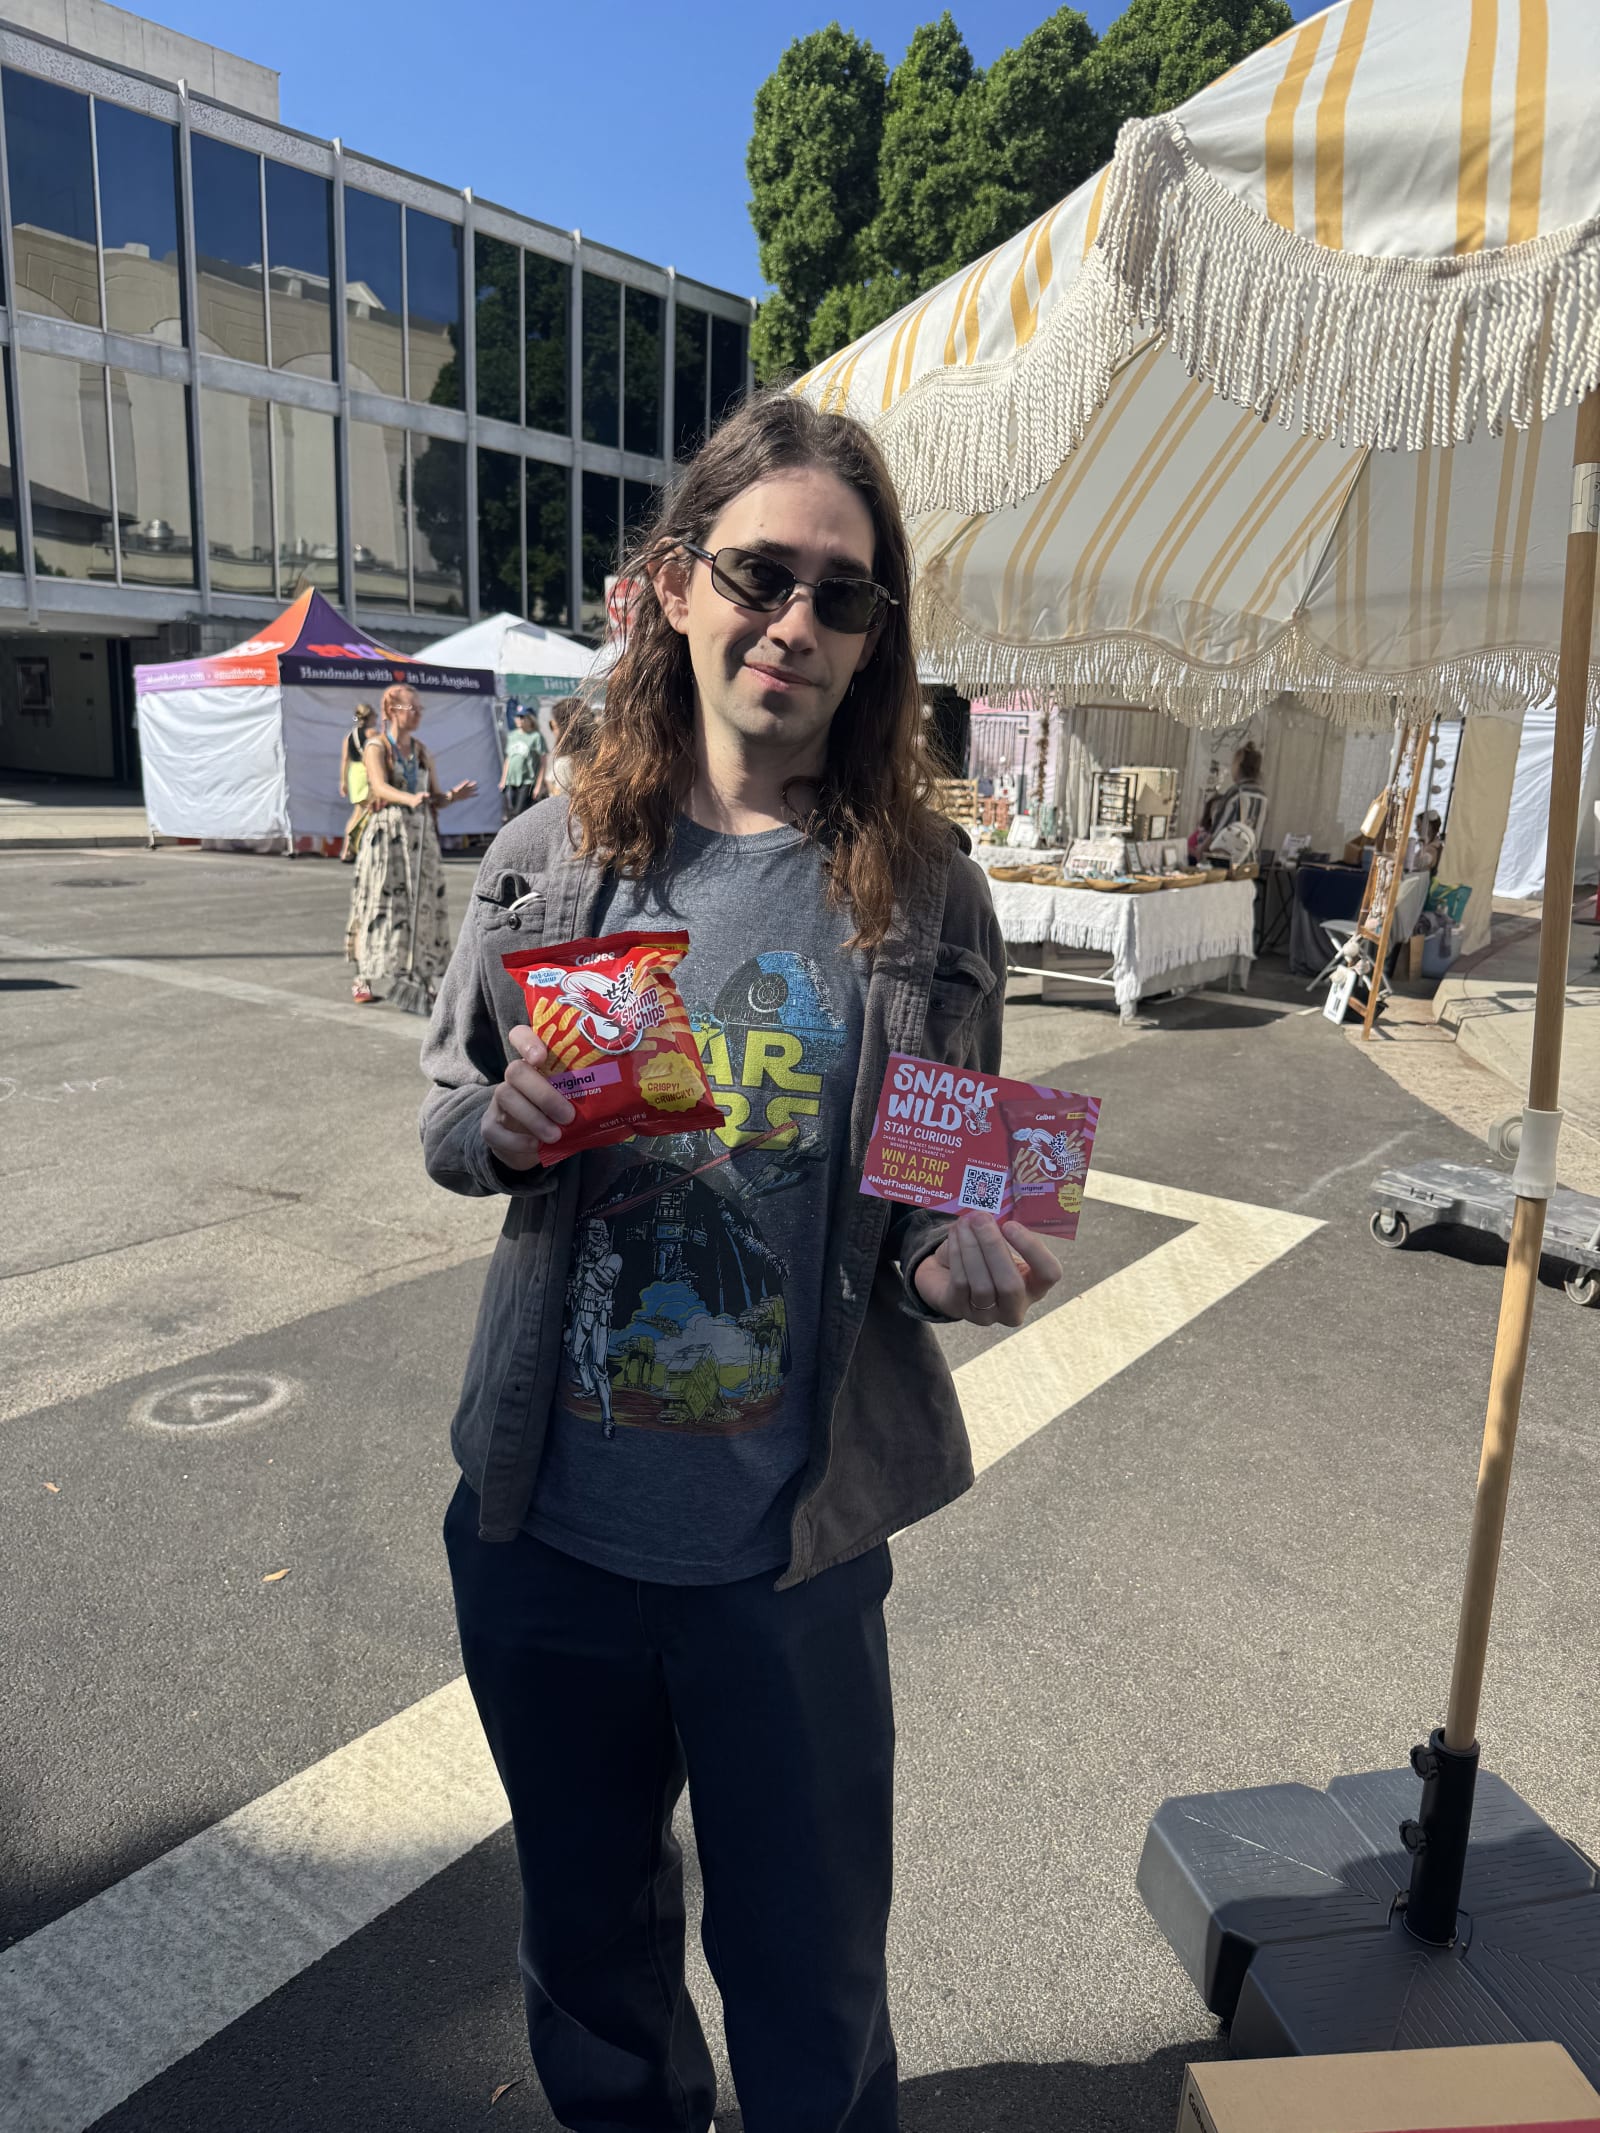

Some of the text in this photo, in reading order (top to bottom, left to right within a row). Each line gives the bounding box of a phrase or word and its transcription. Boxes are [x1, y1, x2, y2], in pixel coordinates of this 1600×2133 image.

[299, 666, 480, 689] Handmade with in Los Angeles
[575, 951, 616, 967] Calbee
[621, 988, 658, 1025] Shrimp
[634, 1004, 665, 1030] Chips
[552, 1072, 596, 1090] original
[647, 1082, 680, 1092] CRISPY!
[893, 1063, 998, 1108] SNACK
[655, 1087, 696, 1104] CRUNCHY!
[887, 1094, 962, 1131] WILD
[1035, 1113, 1056, 1121] Calbee
[883, 1120, 963, 1148] STAY CURIOUS
[881, 1147, 950, 1173] WIN A TRIP
[1057, 1152, 1080, 1165] Shrimp
[1063, 1160, 1081, 1172] Chips
[882, 1162, 944, 1188] TO JAPAN
